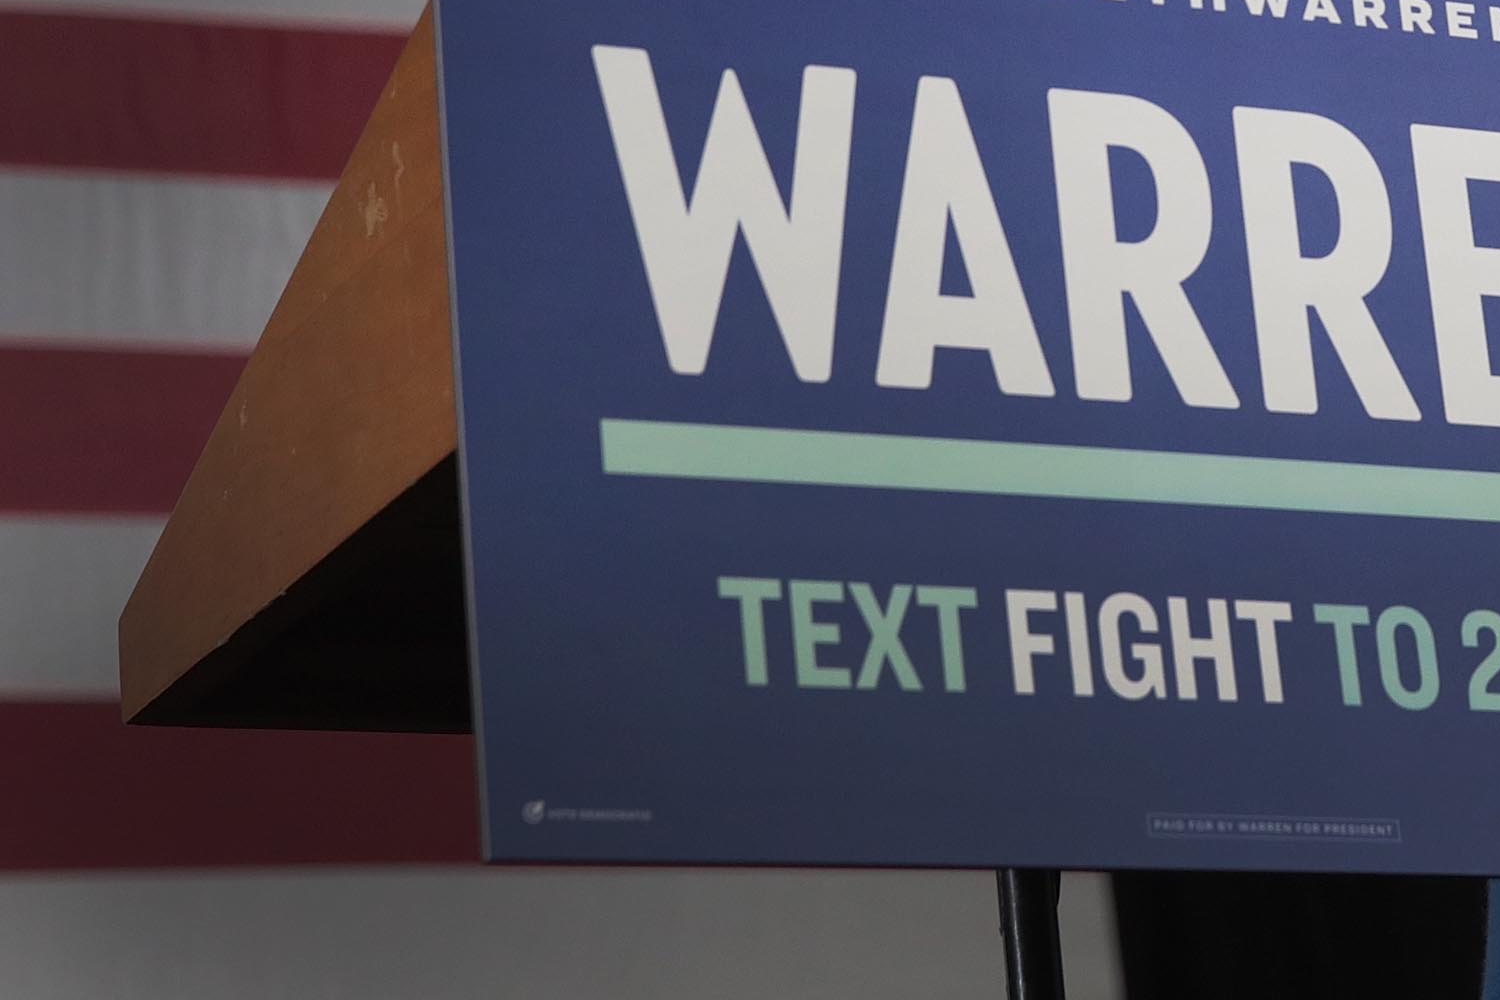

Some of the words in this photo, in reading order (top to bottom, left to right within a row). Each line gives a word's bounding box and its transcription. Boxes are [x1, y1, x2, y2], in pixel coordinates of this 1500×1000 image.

[717, 577, 978, 692] TEXT
[1005, 589, 1293, 703] FIGHT
[1313, 603, 1440, 711] TO
[1153, 818, 1185, 832] PAID
[1188, 819, 1214, 832] FOR
[1238, 820, 1292, 834] WARREN
[1295, 822, 1320, 834] FOR
[1323, 822, 1393, 836] PRESIDENT
